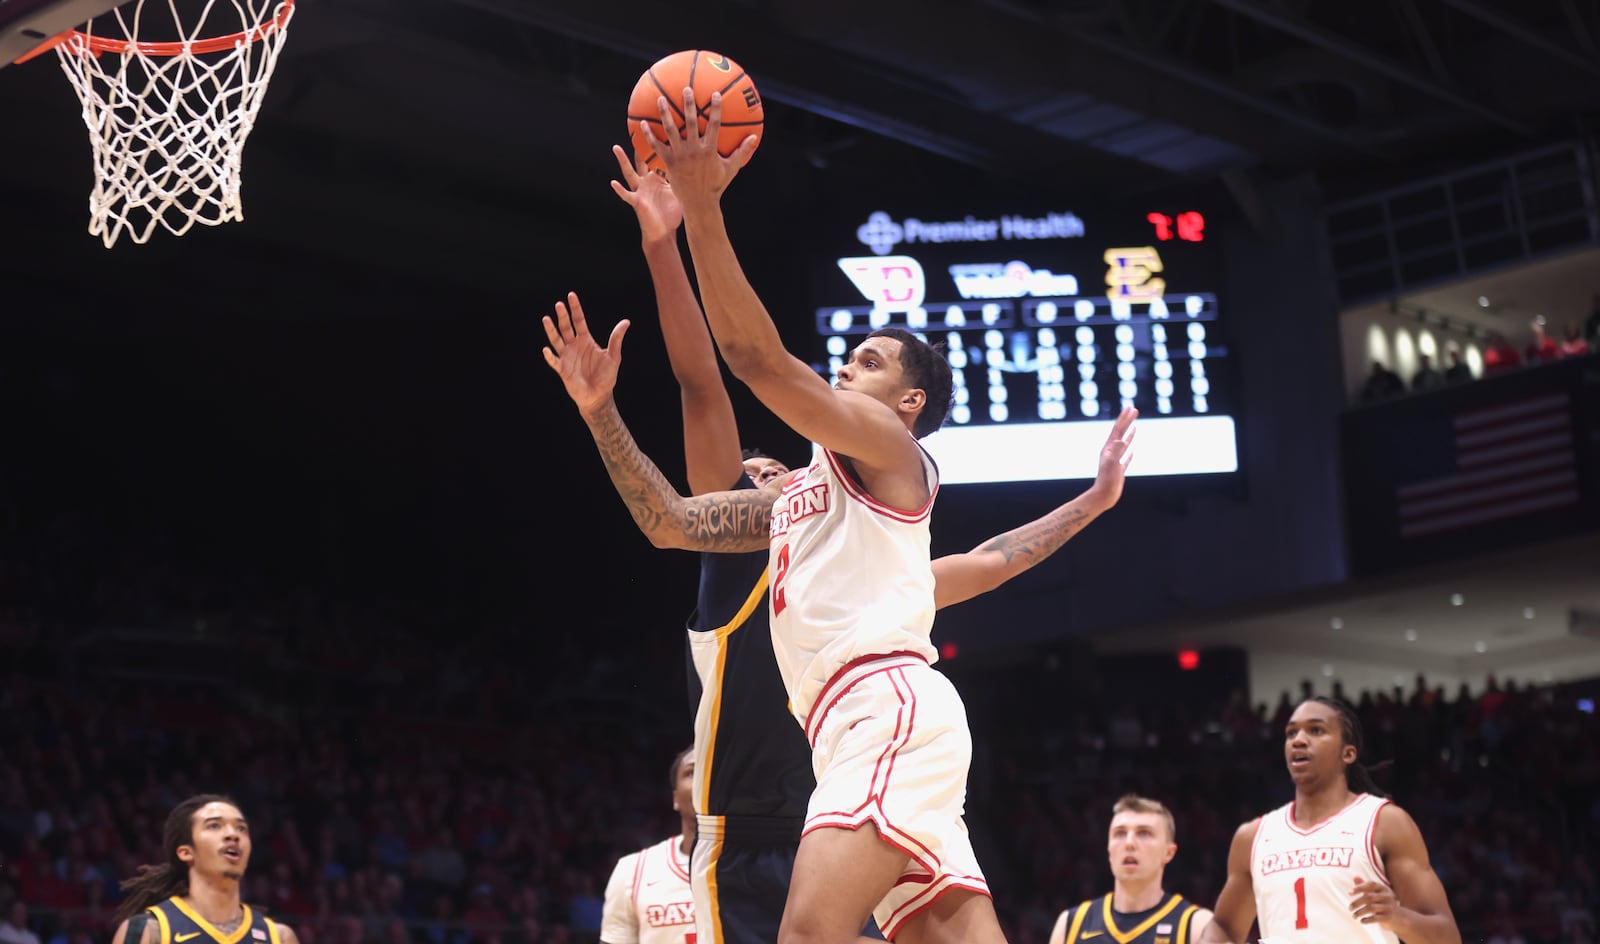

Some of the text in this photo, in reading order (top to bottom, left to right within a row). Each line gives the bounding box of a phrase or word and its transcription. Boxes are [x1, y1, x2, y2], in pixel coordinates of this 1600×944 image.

[904, 211, 1085, 243] Premier Health
[1146, 210, 1205, 242] 7:12
[773, 543, 790, 618] 2
[1261, 847, 1354, 876] DAYTON
[1294, 877, 1308, 930] 1
